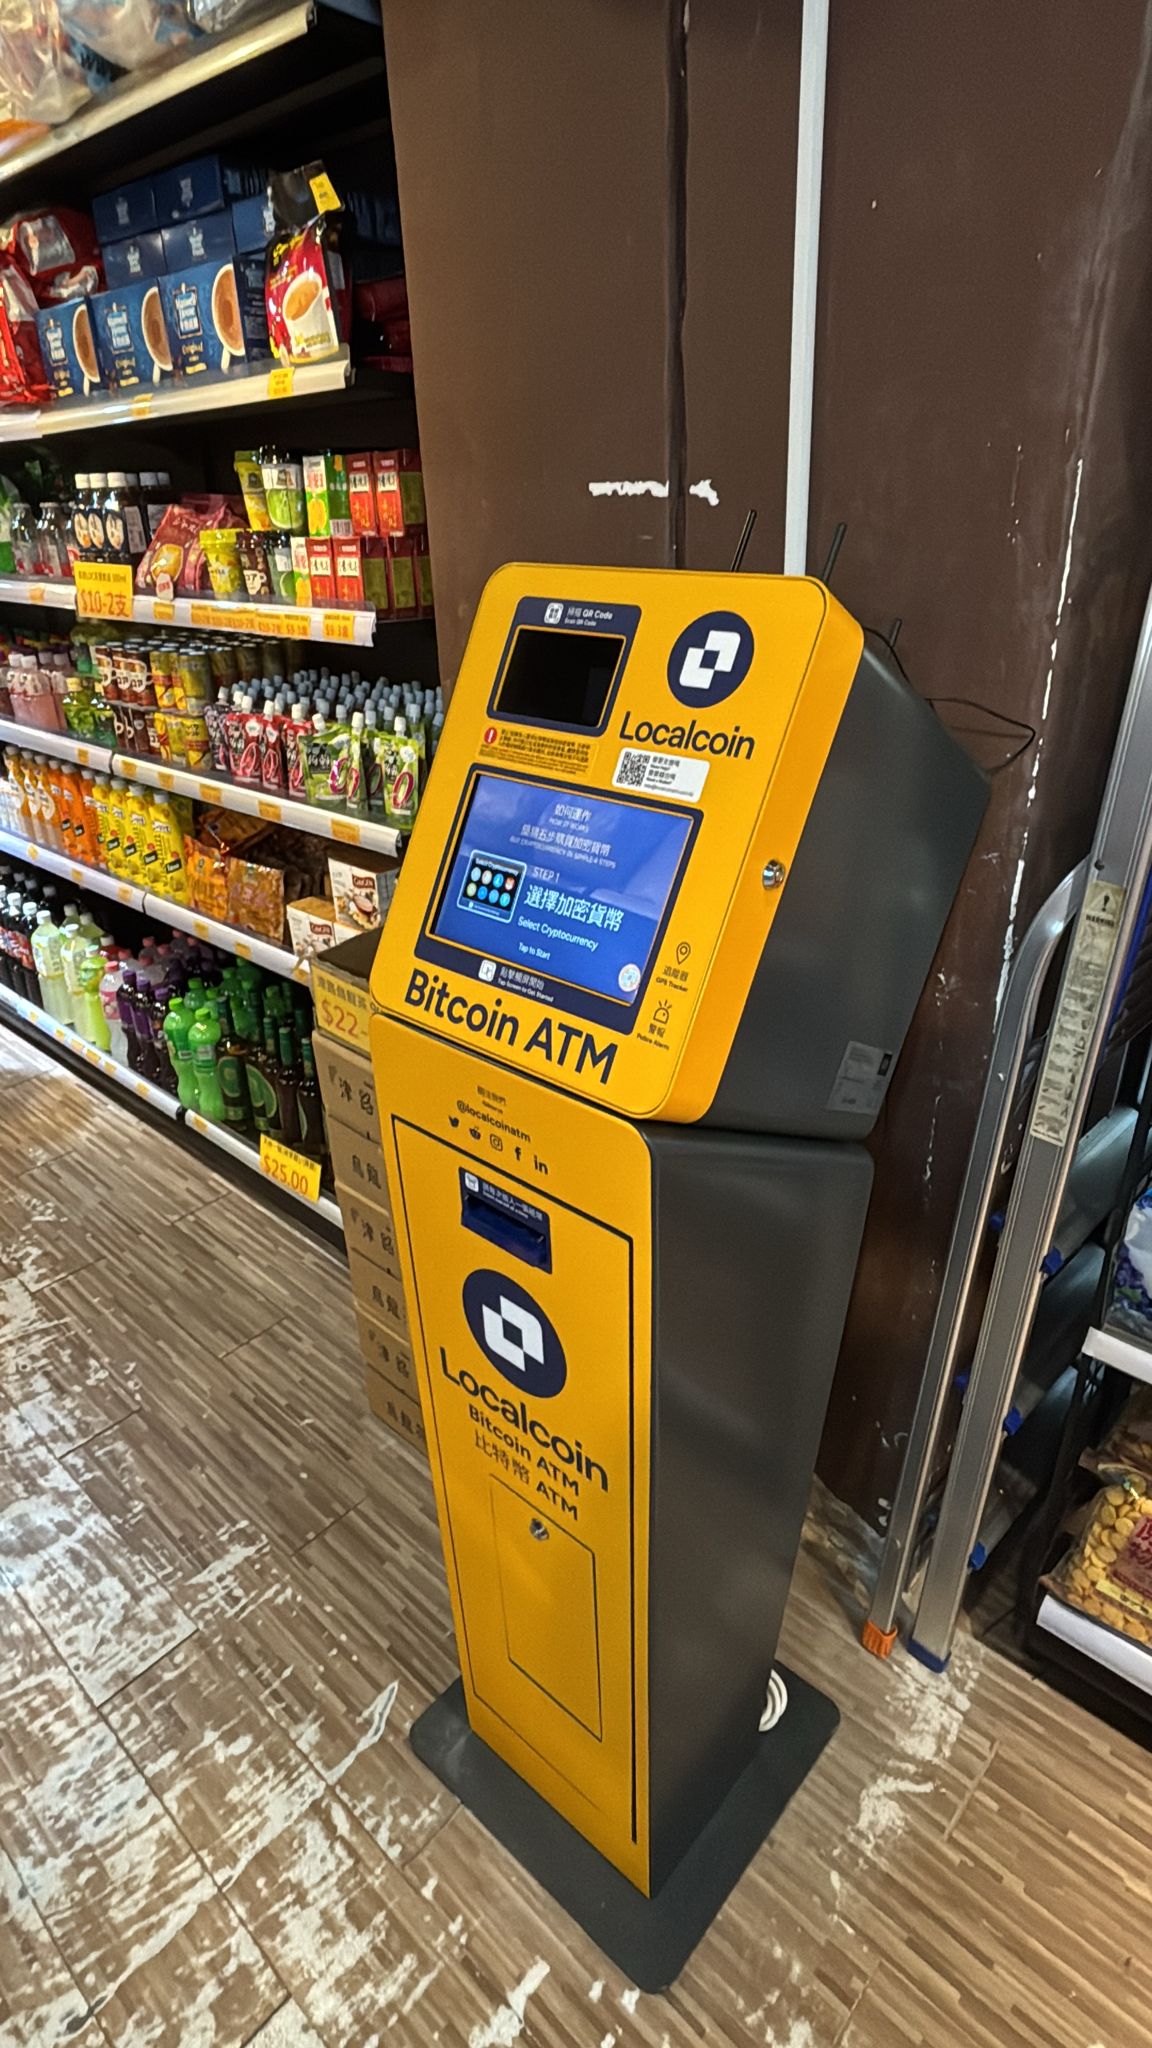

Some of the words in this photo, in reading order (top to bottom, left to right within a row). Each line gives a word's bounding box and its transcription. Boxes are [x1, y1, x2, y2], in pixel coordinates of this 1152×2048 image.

[582, 609, 593, 618] QR
[594, 610, 614, 620] Code
[619, 710, 755, 760] Localcoin
[532, 866, 555, 881] STEP
[524, 884, 624, 932] 選擇加密貨幣
[518, 916, 540, 932] Select
[541, 924, 599, 952] Cryptocurrency
[518, 942, 528, 954] Tap
[529, 945, 535, 954] to
[536, 947, 551, 960] Start
[405, 968, 519, 1046] Bitcoin
[523, 1017, 619, 1085] ATM
[457, 1100, 531, 1143] @localcoinatm
[263, 1154, 308, 1195] $25.00
[440, 1346, 608, 1493] Localcoin
[469, 1403, 531, 1461] Bitcoin
[537, 1456, 579, 1497] ATM
[475, 1429, 529, 1485] 比特幣
[536, 1481, 578, 1520] ATM
